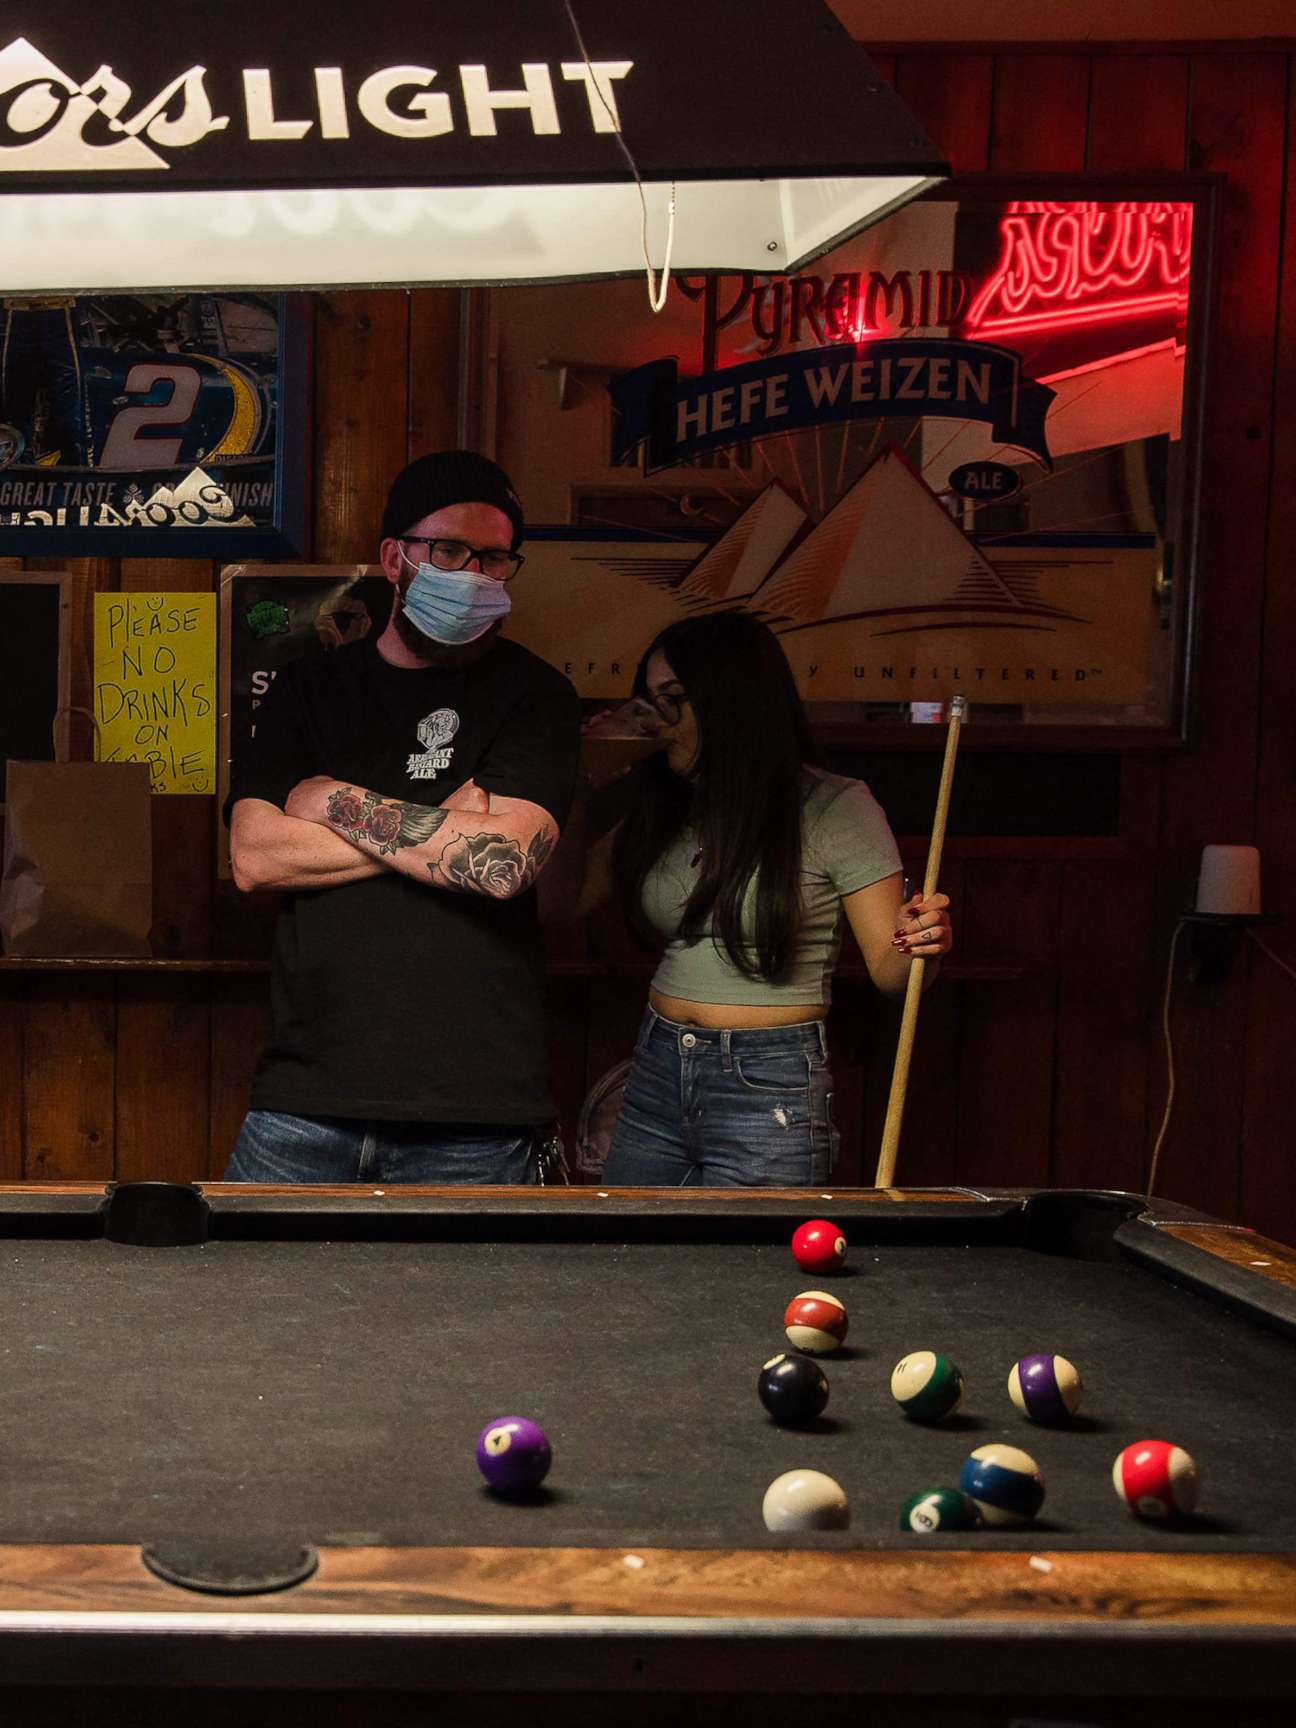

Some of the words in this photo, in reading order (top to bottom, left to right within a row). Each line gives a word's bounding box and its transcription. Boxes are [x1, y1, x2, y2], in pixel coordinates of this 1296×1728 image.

[242, 61, 634, 140] LIGHT
[675, 271, 970, 376] PYRAMID
[97, 363, 203, 467] 2
[675, 373, 791, 443] HEFE
[803, 357, 992, 409] WEIZEN
[0, 481, 61, 507] GREAT
[62, 481, 117, 507] TASTE
[222, 482, 273, 507] INISH
[963, 471, 1003, 491] ALE
[123, 645, 176, 680] NO
[97, 678, 211, 728] DRINKS
[135, 724, 168, 746] ON
